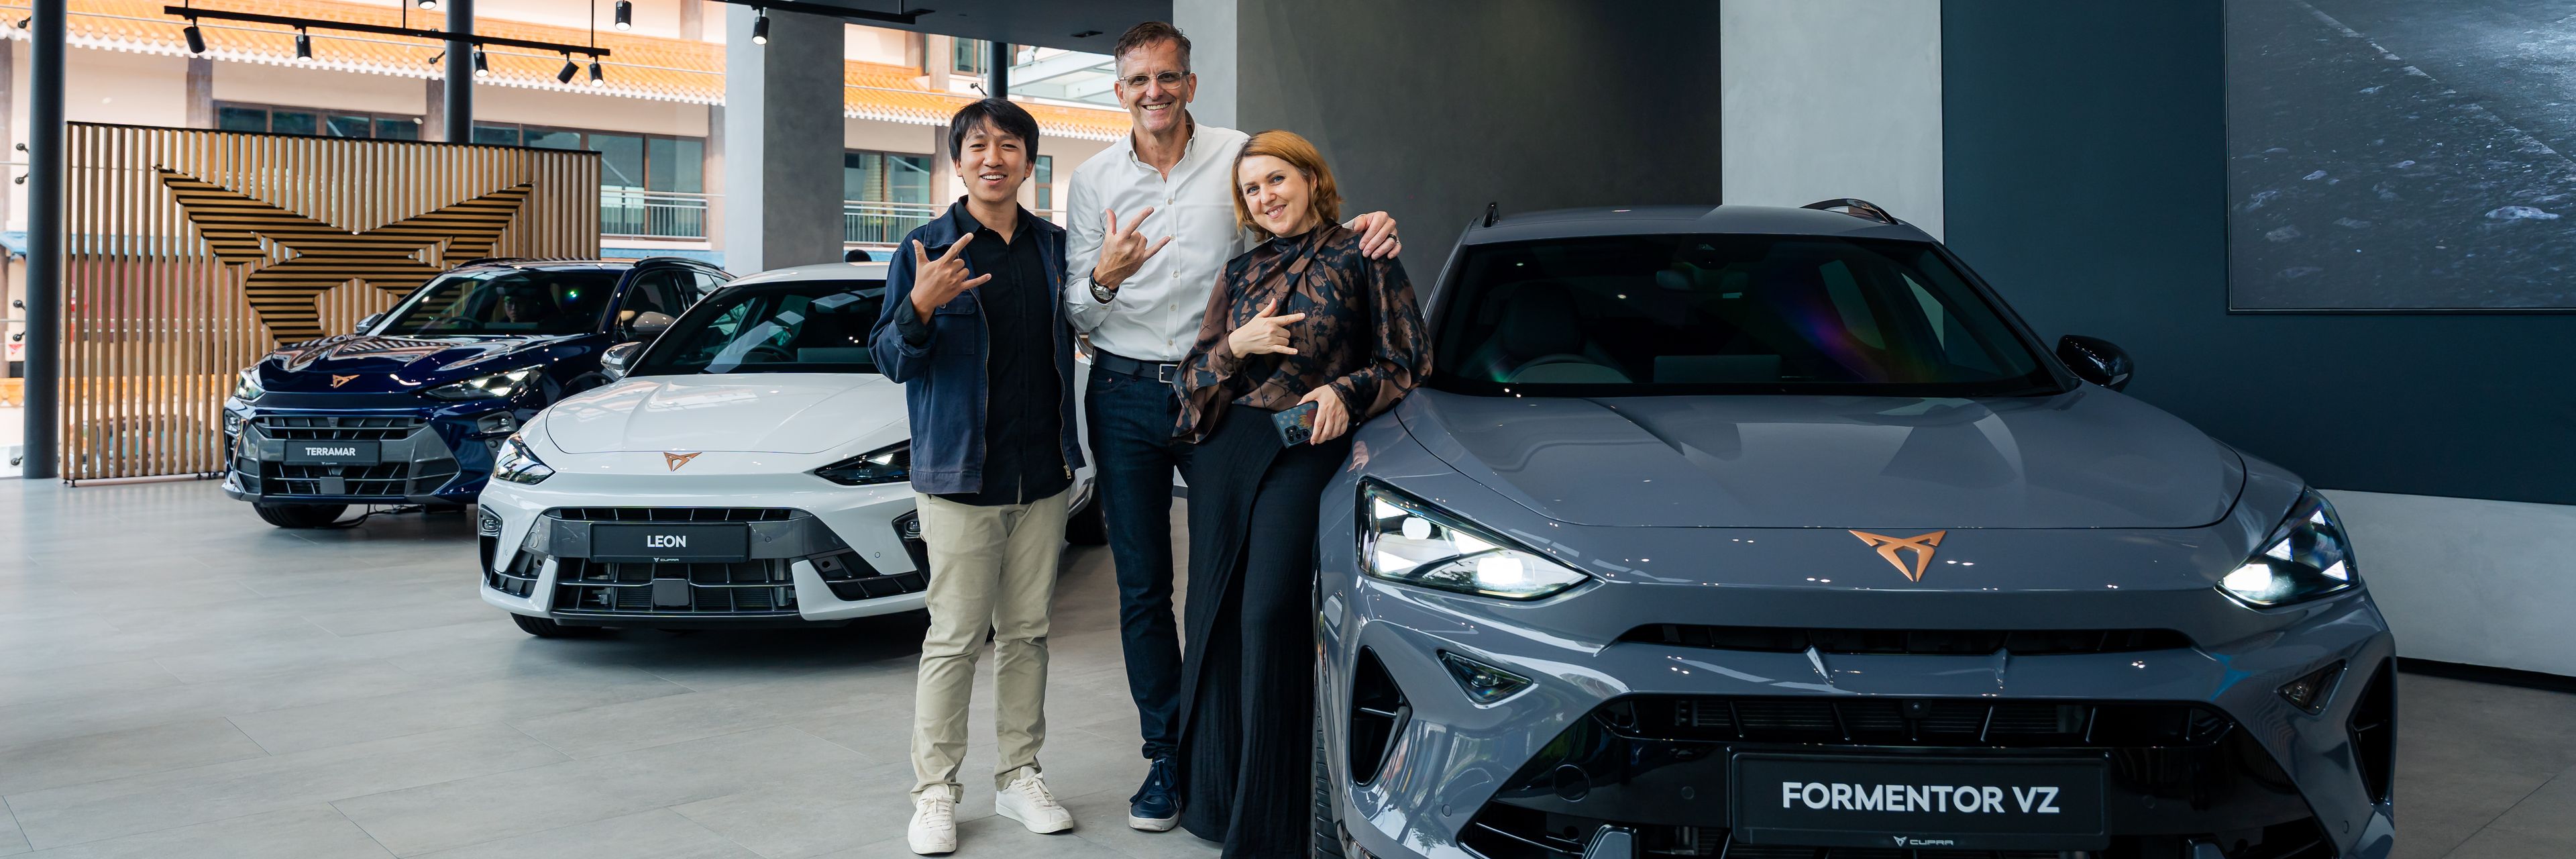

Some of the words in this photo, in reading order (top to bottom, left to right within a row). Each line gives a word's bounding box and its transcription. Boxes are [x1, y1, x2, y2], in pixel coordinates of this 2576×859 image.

[305, 447, 356, 456] TERRAMAR
[647, 535, 686, 548] LEON
[1782, 782, 2005, 813] FORMENTOR
[2012, 787, 2060, 813] VZ
